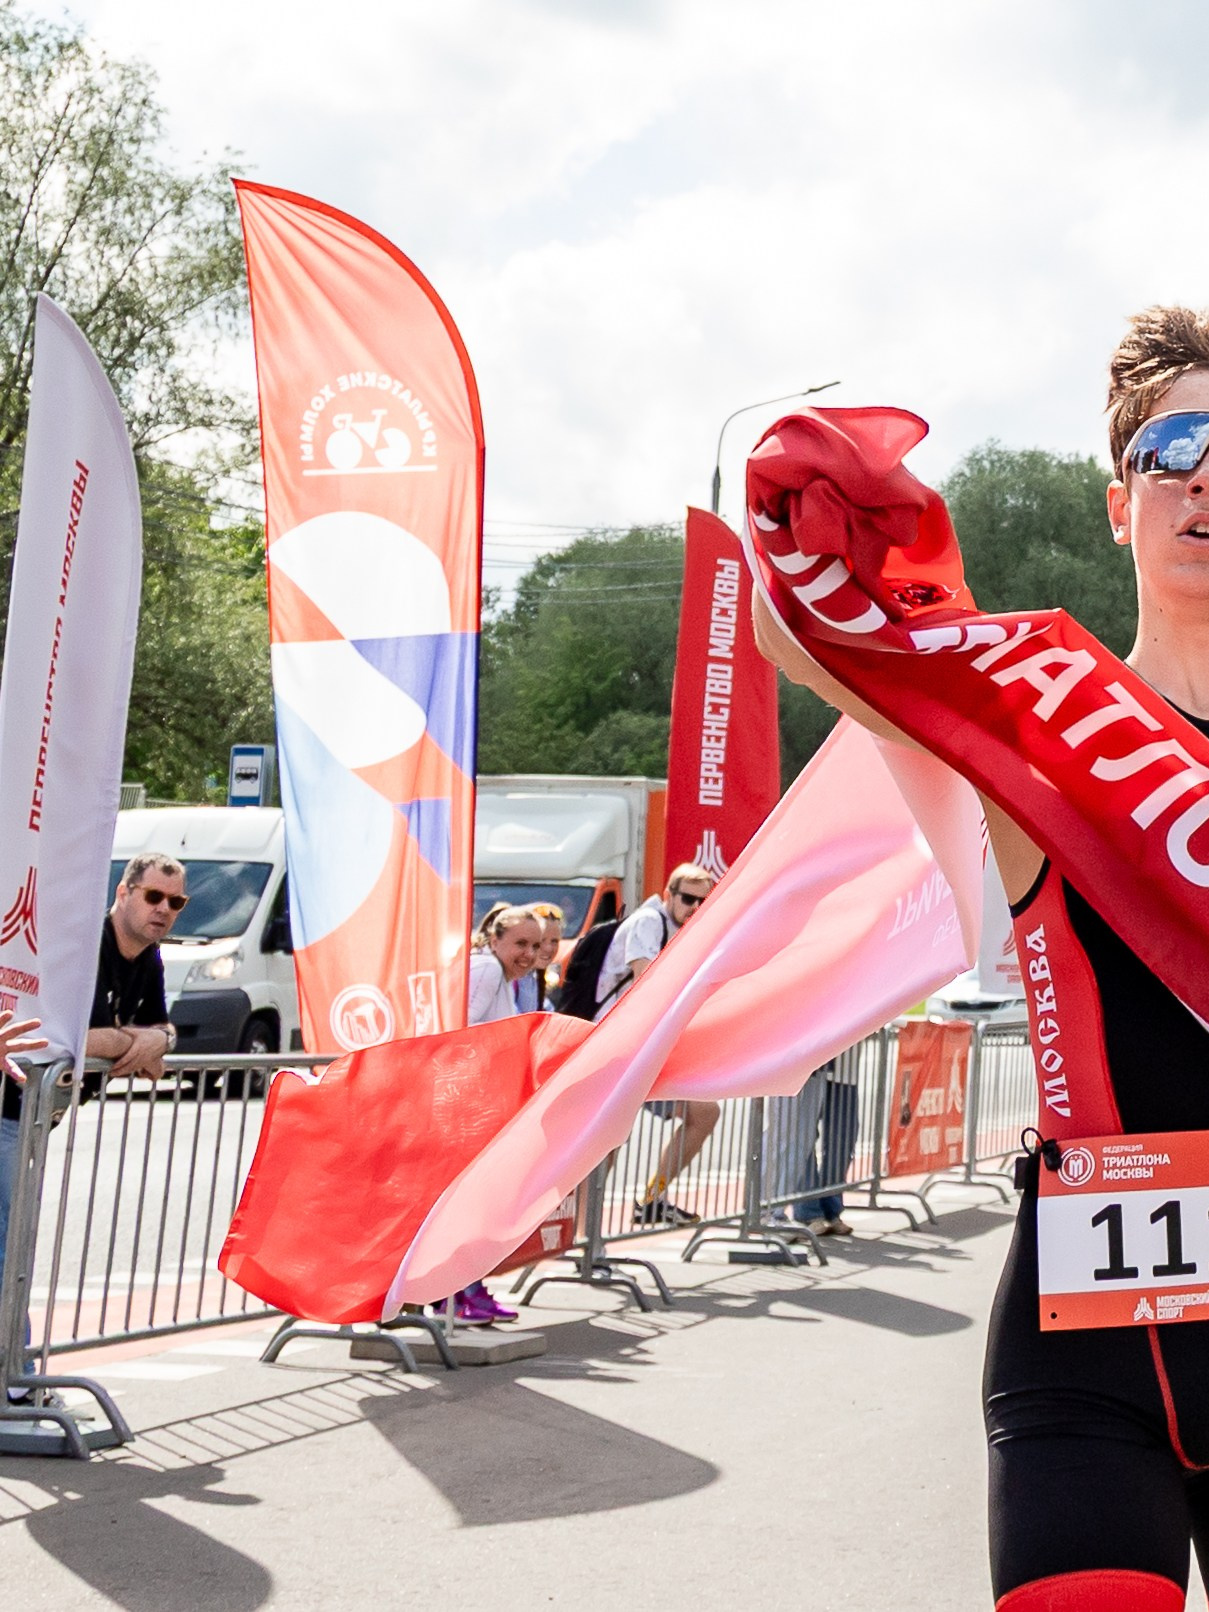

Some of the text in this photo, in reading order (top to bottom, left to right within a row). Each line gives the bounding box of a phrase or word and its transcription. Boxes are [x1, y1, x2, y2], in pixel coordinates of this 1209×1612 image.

[698, 557, 740, 807] ПЕРВЕНСТВО МОСКВЫ
[1102, 1153, 1171, 1168] ТРИАТЛОНА
[1102, 1167, 1154, 1181] МОСКВЫ
[1156, 1306, 1184, 1320] СПОРТ
